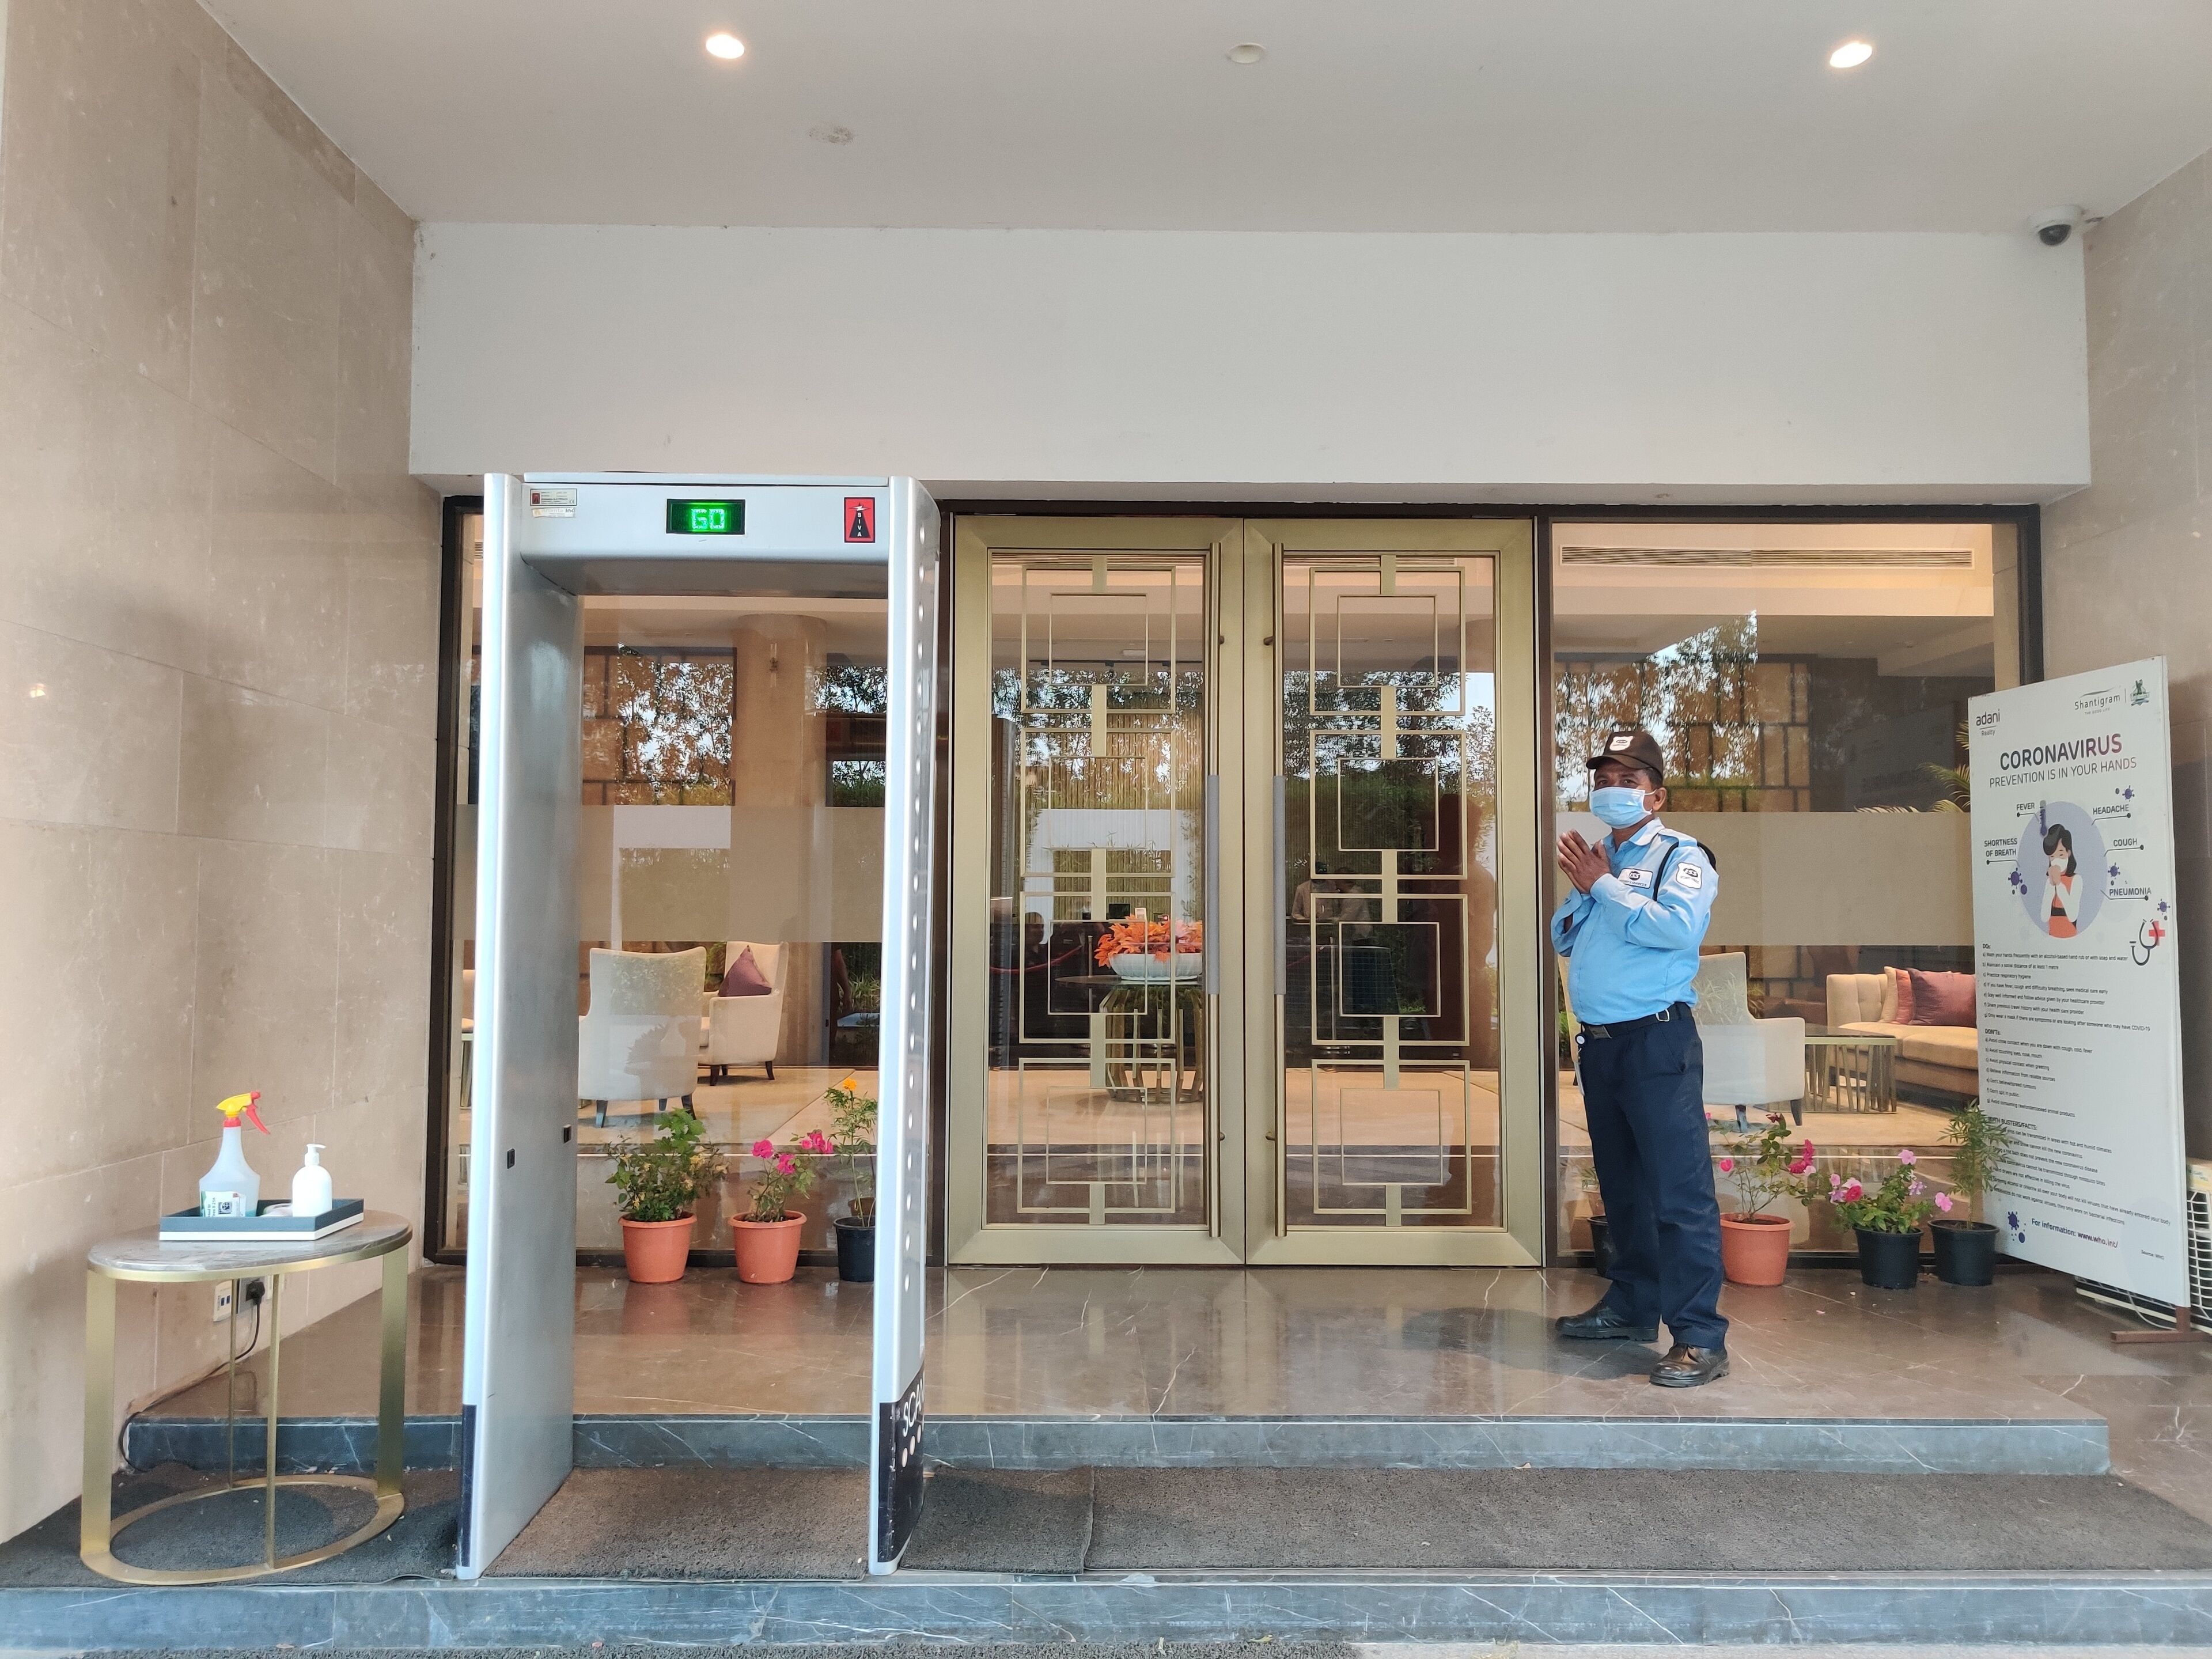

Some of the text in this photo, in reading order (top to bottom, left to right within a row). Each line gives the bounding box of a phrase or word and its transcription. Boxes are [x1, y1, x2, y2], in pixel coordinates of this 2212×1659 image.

[691, 509, 725, 530] GO
[2075, 694, 2120, 710] Shantigram
[1976, 708, 2000, 726] adani
[2000, 733, 2122, 770] CORONAVIRUS
[1990, 757, 2136, 788] PREVENTION IS IN YOUR HANDS
[2016, 802, 2035, 811] FEVER
[2093, 804, 2129, 815] HEADACHE
[1984, 838, 2017, 847] SHORTNESS
[2113, 839, 2137, 847] COUGH
[1995, 848, 2016, 857] BREATH
[2109, 888, 2151, 896] PNEUMONIA
[2042, 1222, 2076, 1236] information:
[2078, 1233, 2118, 1247] www.who.int/
